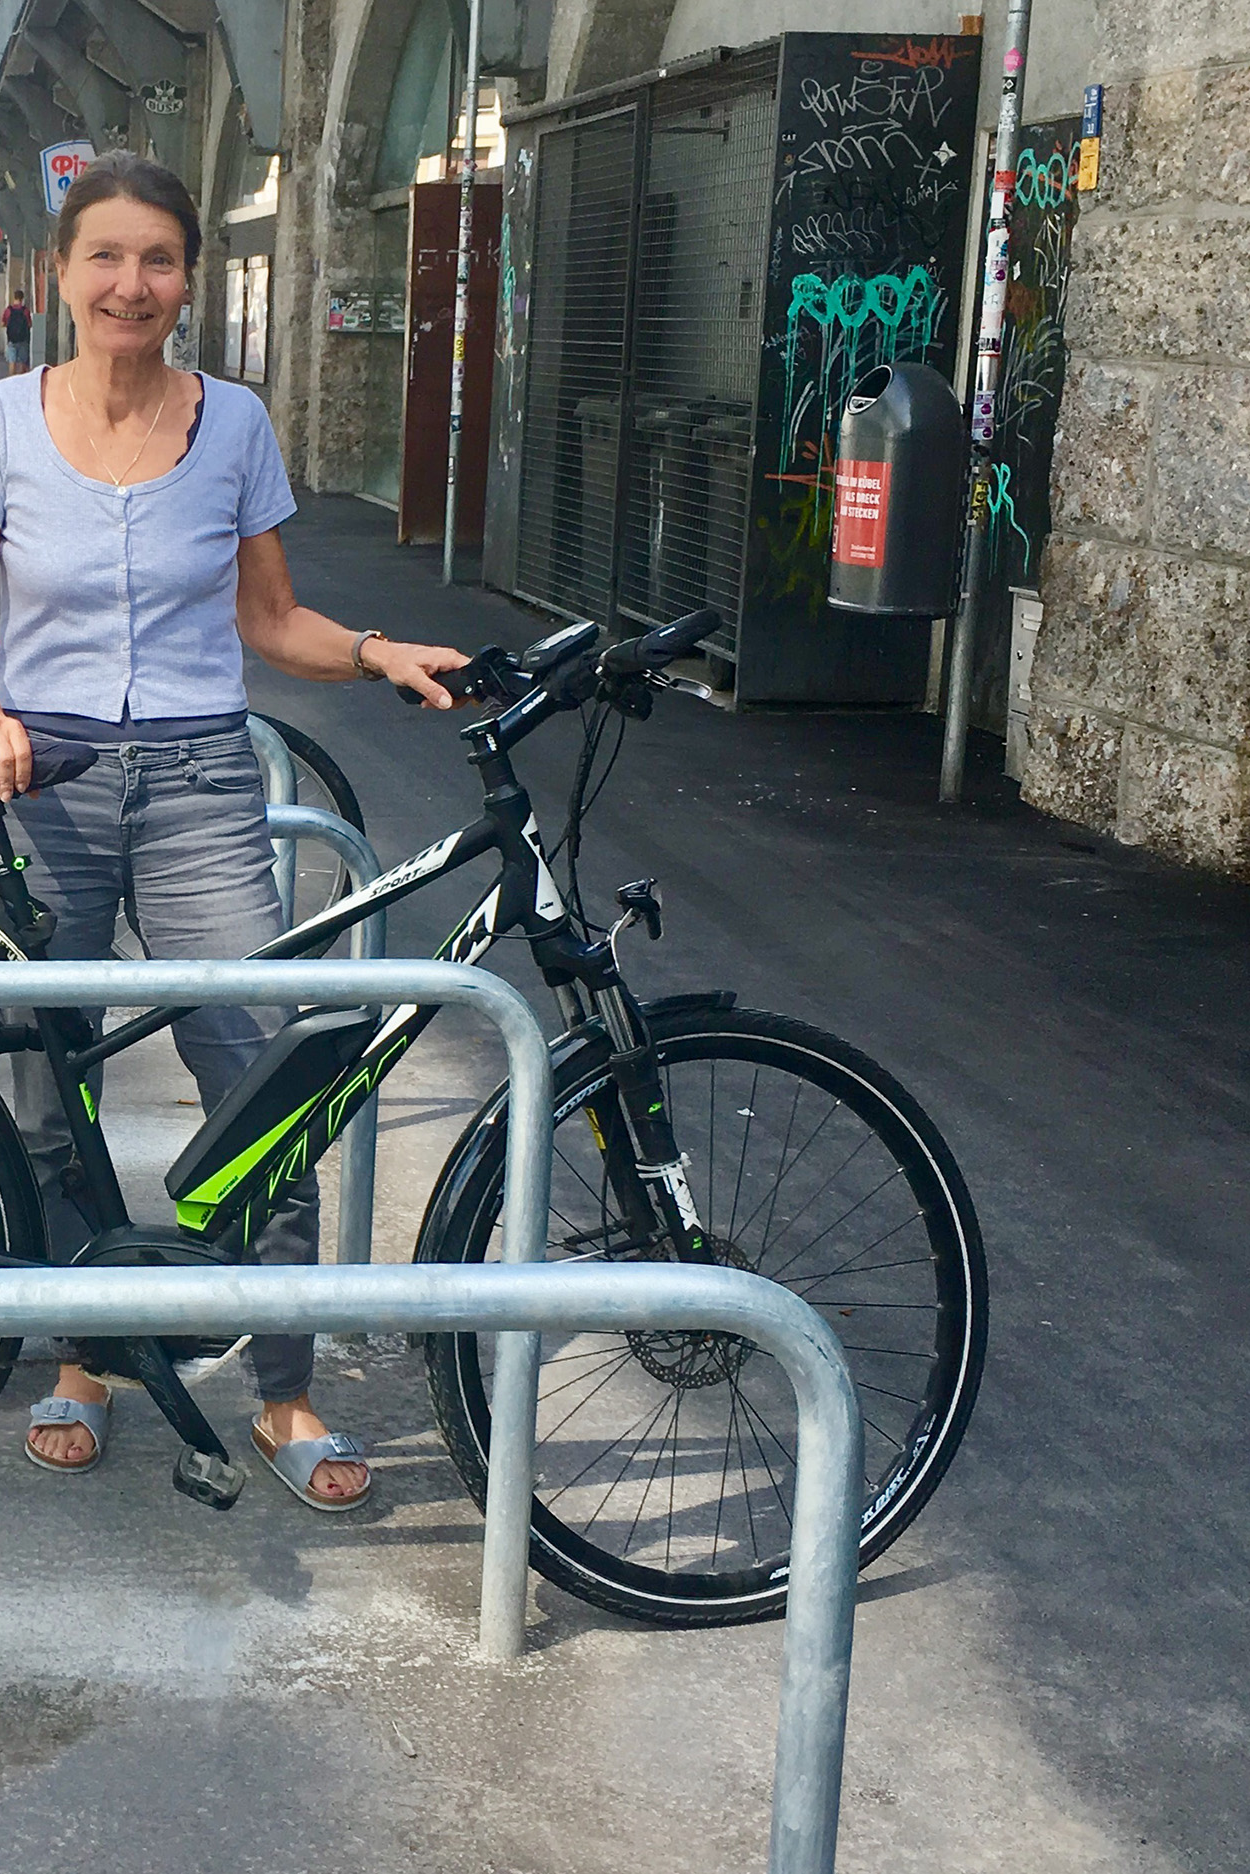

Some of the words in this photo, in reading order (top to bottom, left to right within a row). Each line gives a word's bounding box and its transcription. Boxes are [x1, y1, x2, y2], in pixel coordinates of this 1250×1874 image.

[858, 475, 881, 489] KÜBEL
[856, 493, 880, 505] DRECK
[848, 507, 879, 519] STECKEN
[369, 866, 423, 898] SPORT
